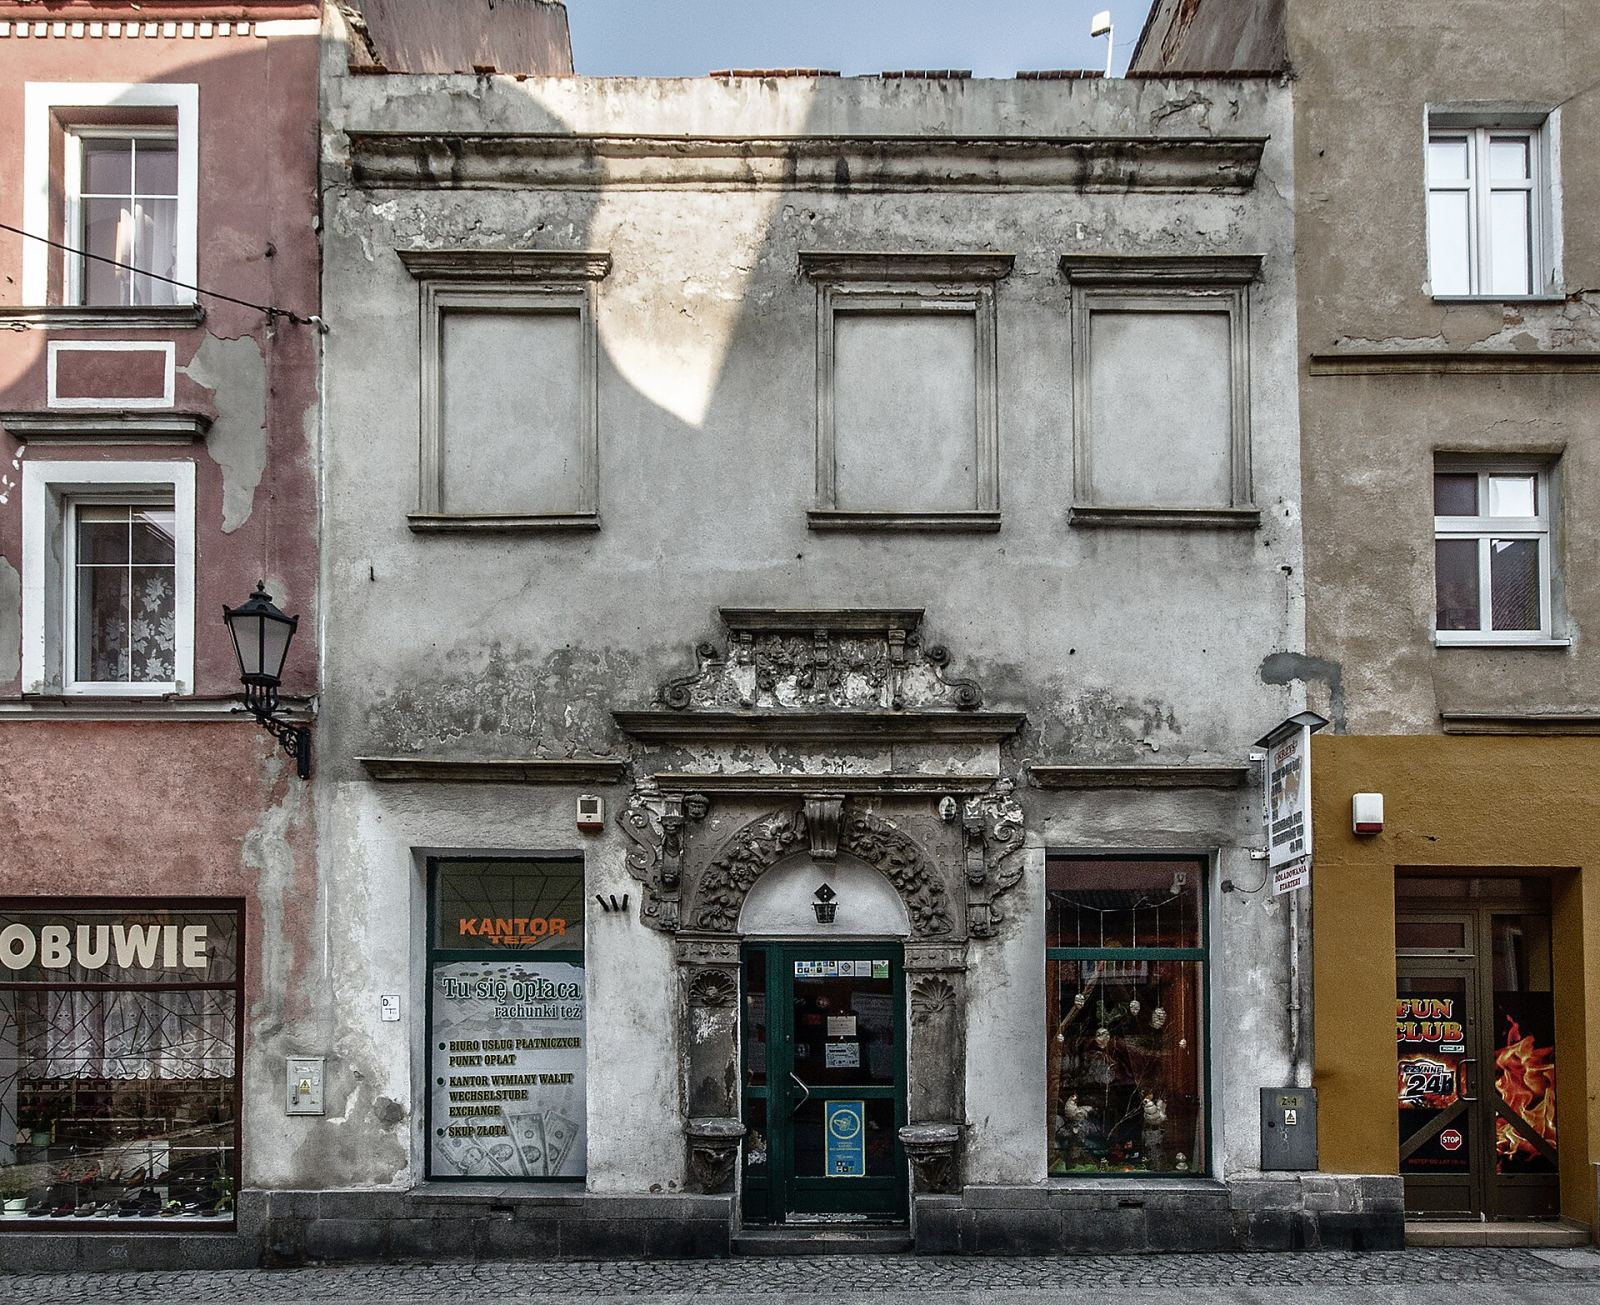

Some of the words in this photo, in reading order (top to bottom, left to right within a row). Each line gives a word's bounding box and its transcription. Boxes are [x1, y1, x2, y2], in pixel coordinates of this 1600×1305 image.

[459, 917, 567, 936] KANTOR
[0, 924, 207, 969] OBUWIE
[443, 978, 469, 999] Tu
[477, 978, 507, 1003] się
[513, 978, 581, 1003] opłaca
[495, 1004, 556, 1018] rachunki
[562, 1004, 582, 1018] też
[1396, 998, 1453, 1019] FUN
[1396, 1022, 1464, 1043] CLUB
[450, 1040, 480, 1051] BIURO
[482, 1039, 514, 1050] USŁUG
[516, 1037, 581, 1049] PŁATNICZYCH
[449, 1055, 482, 1066] PUNKT
[484, 1054, 516, 1066] OPŁAT
[449, 1075, 489, 1087] KANTOR
[491, 1074, 537, 1085] WYMIANY
[449, 1090, 528, 1101] WECHSELSTUBE
[449, 1105, 501, 1117] EXCHANGE
[449, 1126, 475, 1137] SKUP
[476, 1125, 508, 1136] ZŁOTA
[1442, 1136, 1460, 1144] STOP
